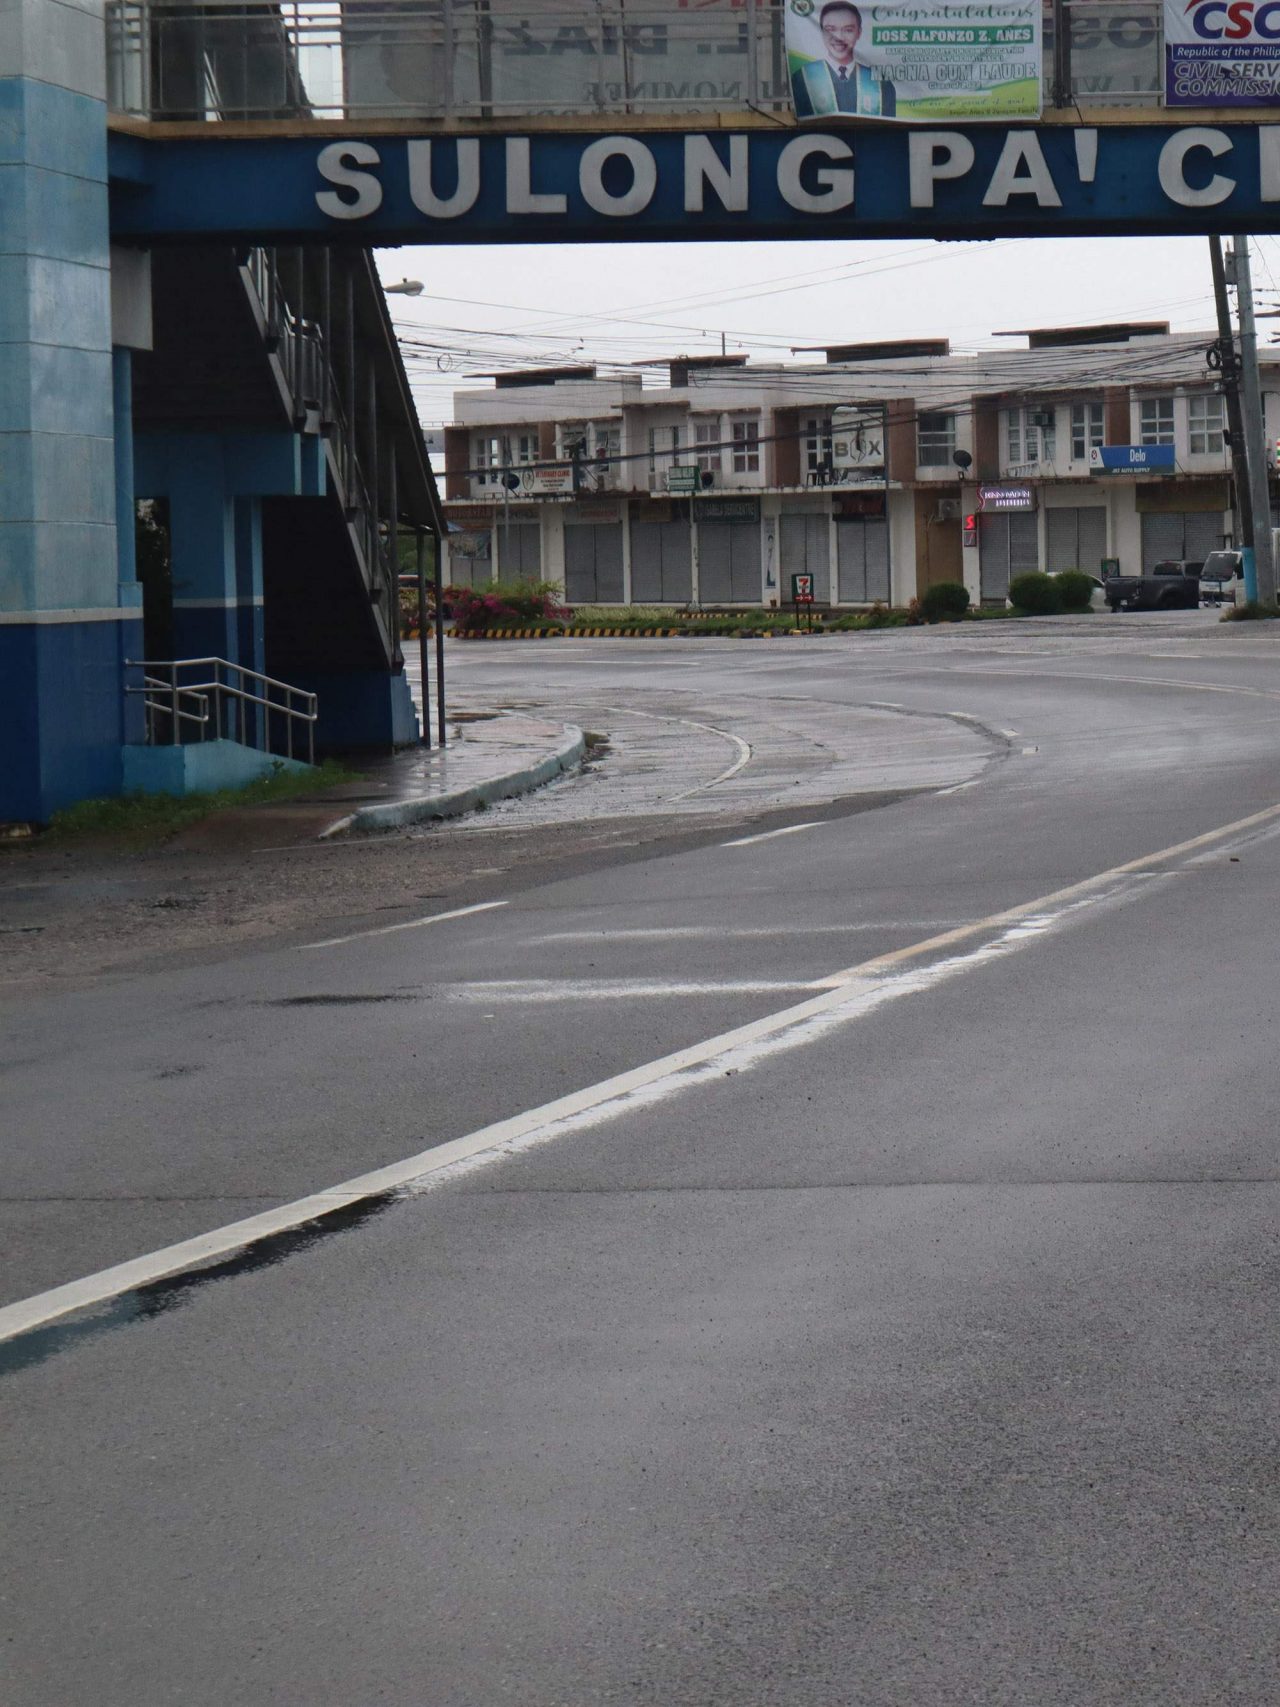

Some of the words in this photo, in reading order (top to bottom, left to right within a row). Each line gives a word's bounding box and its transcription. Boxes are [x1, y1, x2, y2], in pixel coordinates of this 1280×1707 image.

[872, 1, 1034, 21] Congratulations
[876, 30, 908, 42] JOSE
[912, 29, 974, 42] ALFONZO
[978, 29, 991, 42] Z.
[1177, 47, 1218, 58] Republic
[1222, 47, 1233, 58] of
[1234, 47, 1250, 56] the
[871, 64, 930, 81] MAGNA
[936, 63, 973, 80] CUM
[979, 62, 1037, 79] LAUDE
[1174, 62, 1226, 79] CIVIL
[315, 133, 856, 219] SULONG
[1129, 448, 1146, 462] Delo
